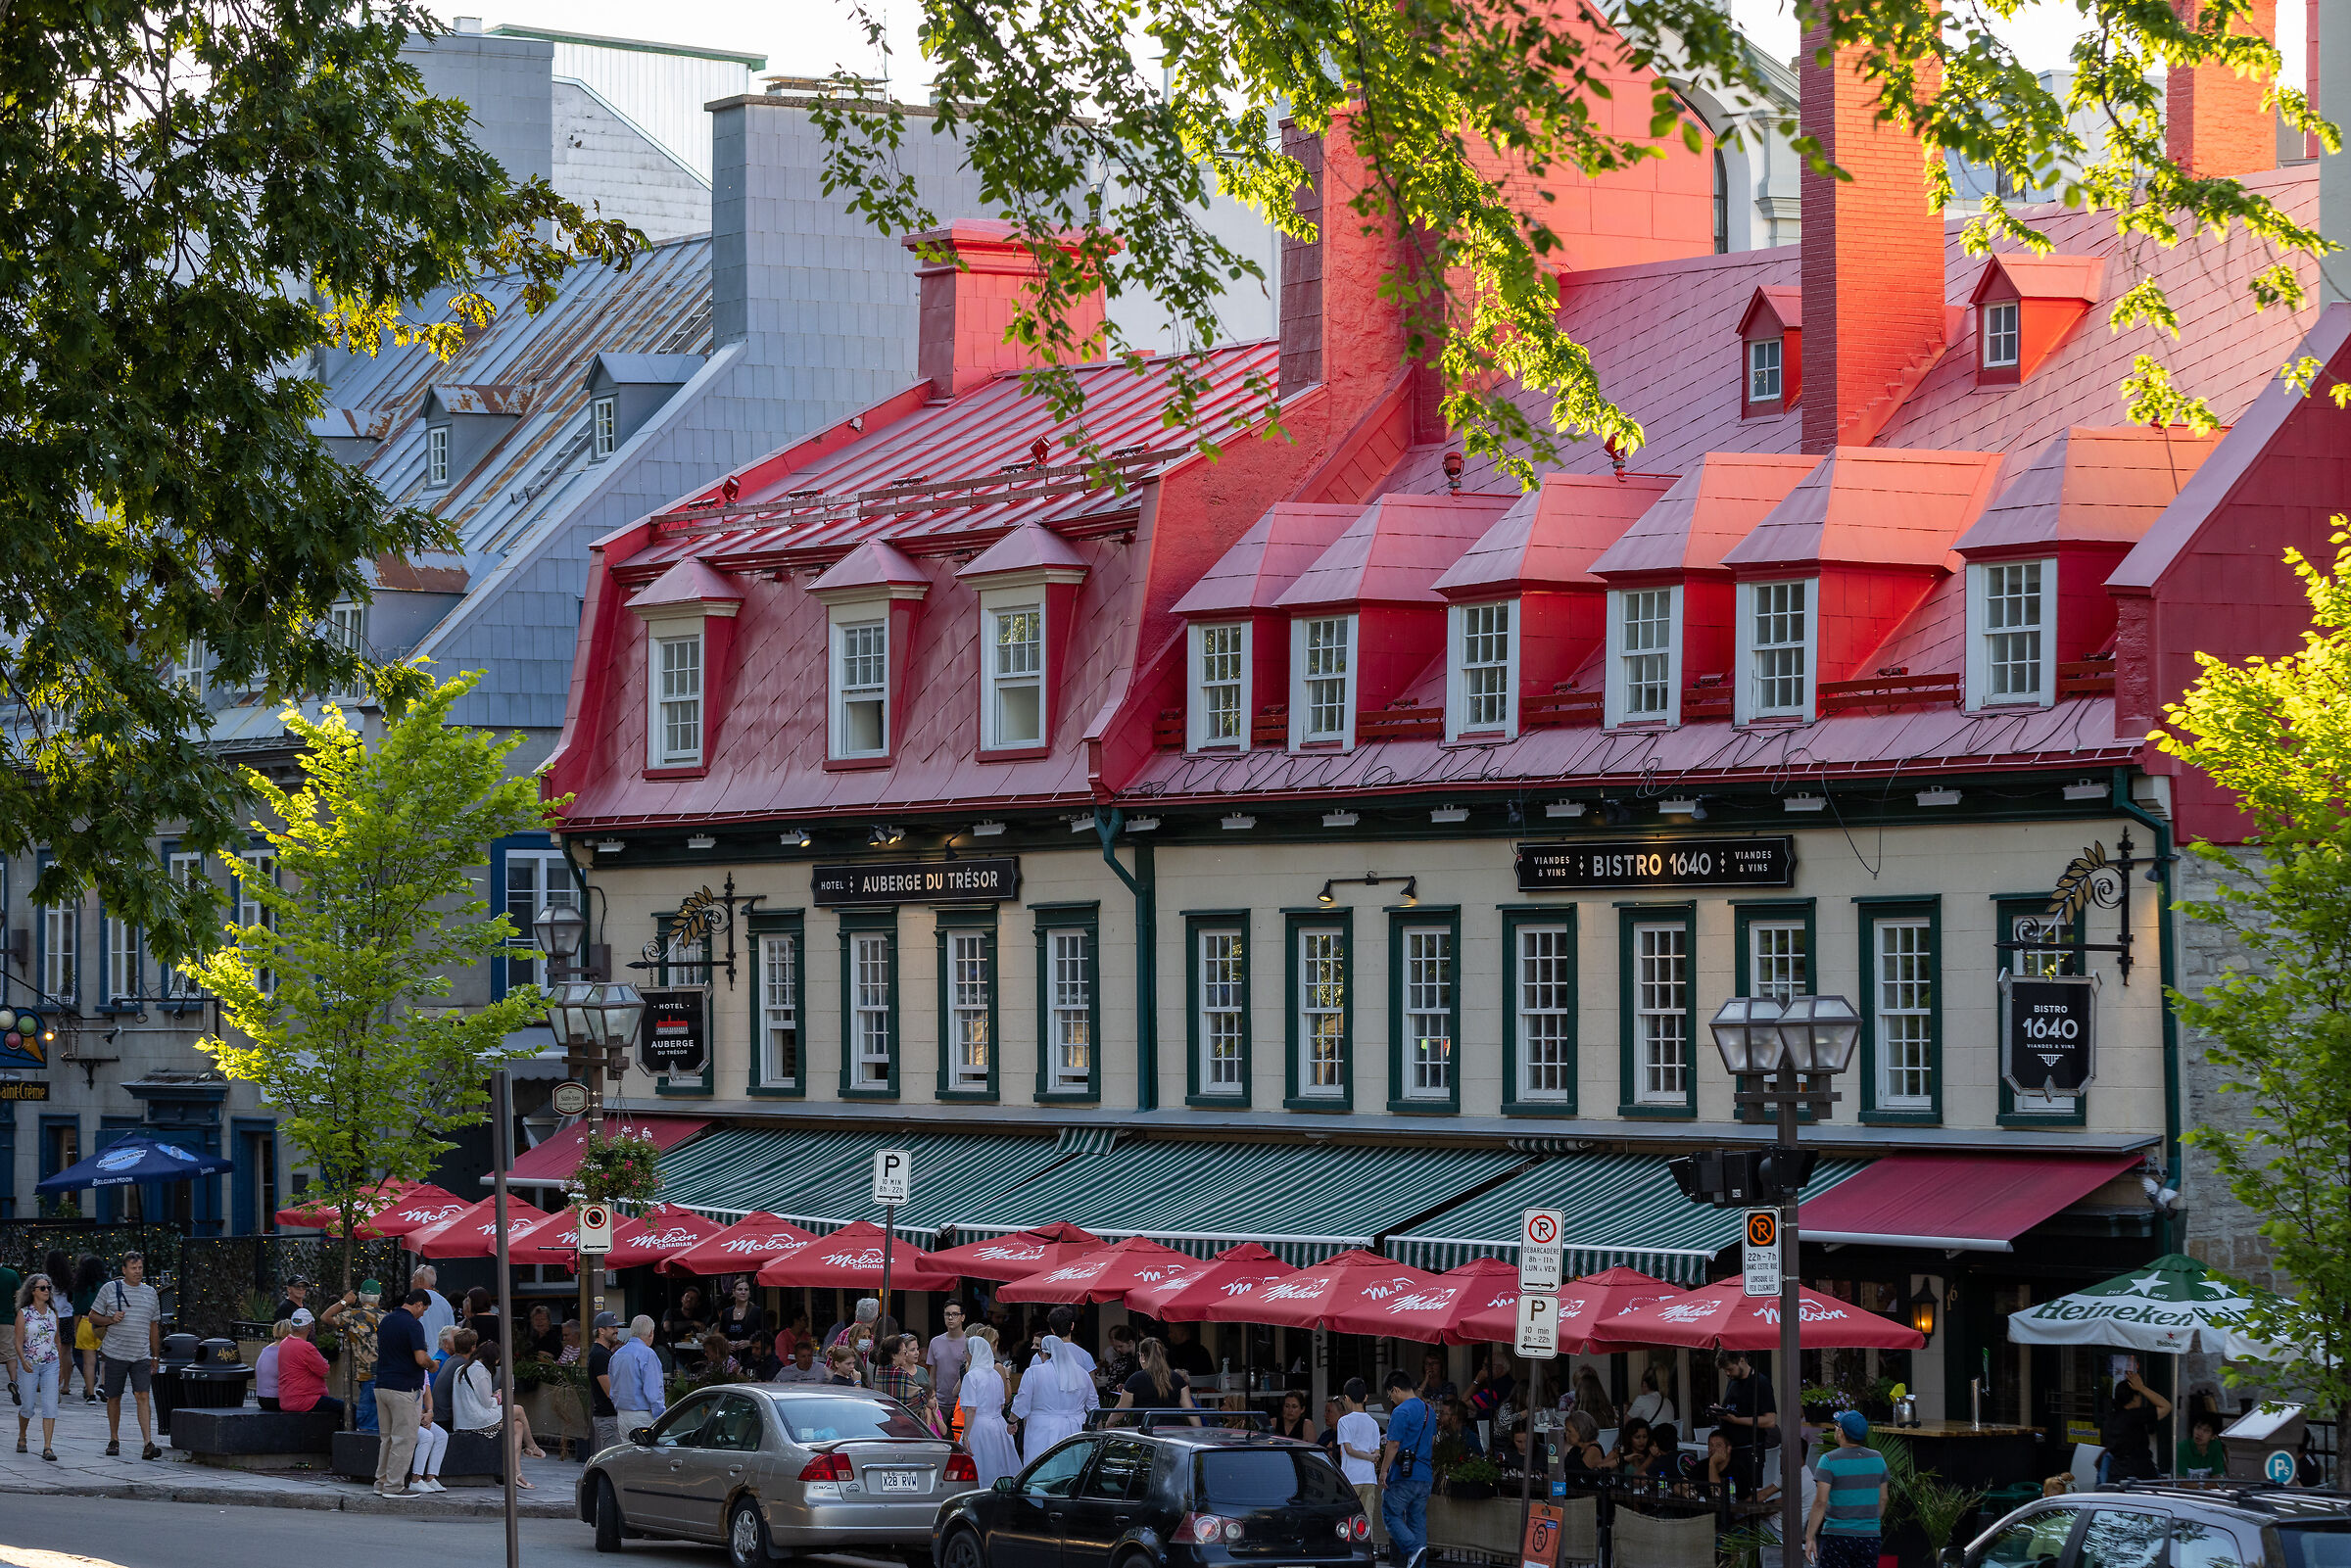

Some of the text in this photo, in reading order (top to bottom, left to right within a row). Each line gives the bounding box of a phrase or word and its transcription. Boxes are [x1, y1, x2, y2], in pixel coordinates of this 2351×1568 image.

[1533, 856, 1570, 865] VIANDES
[1735, 850, 1772, 860] VIANDES
[1593, 850, 1711, 877] BISTRO 1640
[1739, 863, 1768, 873] & VINS
[821, 868, 998, 892] HOTEL AUBERGE DU TRÉSOR
[1538, 868, 1566, 878] & VINS
[2022, 1017, 2079, 1039] 1640
[650, 1039, 695, 1048] AUBERGE
[0, 1082, 45, 1099] aint-Crème
[885, 1156, 900, 1177] P
[627, 1232, 698, 1249] Molson
[721, 1239, 808, 1255] Molson
[1523, 1246, 1559, 1255] DÉBARCADÈRE
[1748, 1253, 1760, 1261] 22h
[1530, 1300, 1546, 1321] P
[1753, 1307, 1849, 1324] Mlson
[2031, 1299, 2194, 1326] Heineken
[1537, 1326, 1550, 1335] min
[883, 1476, 917, 1487] X28 RVW
